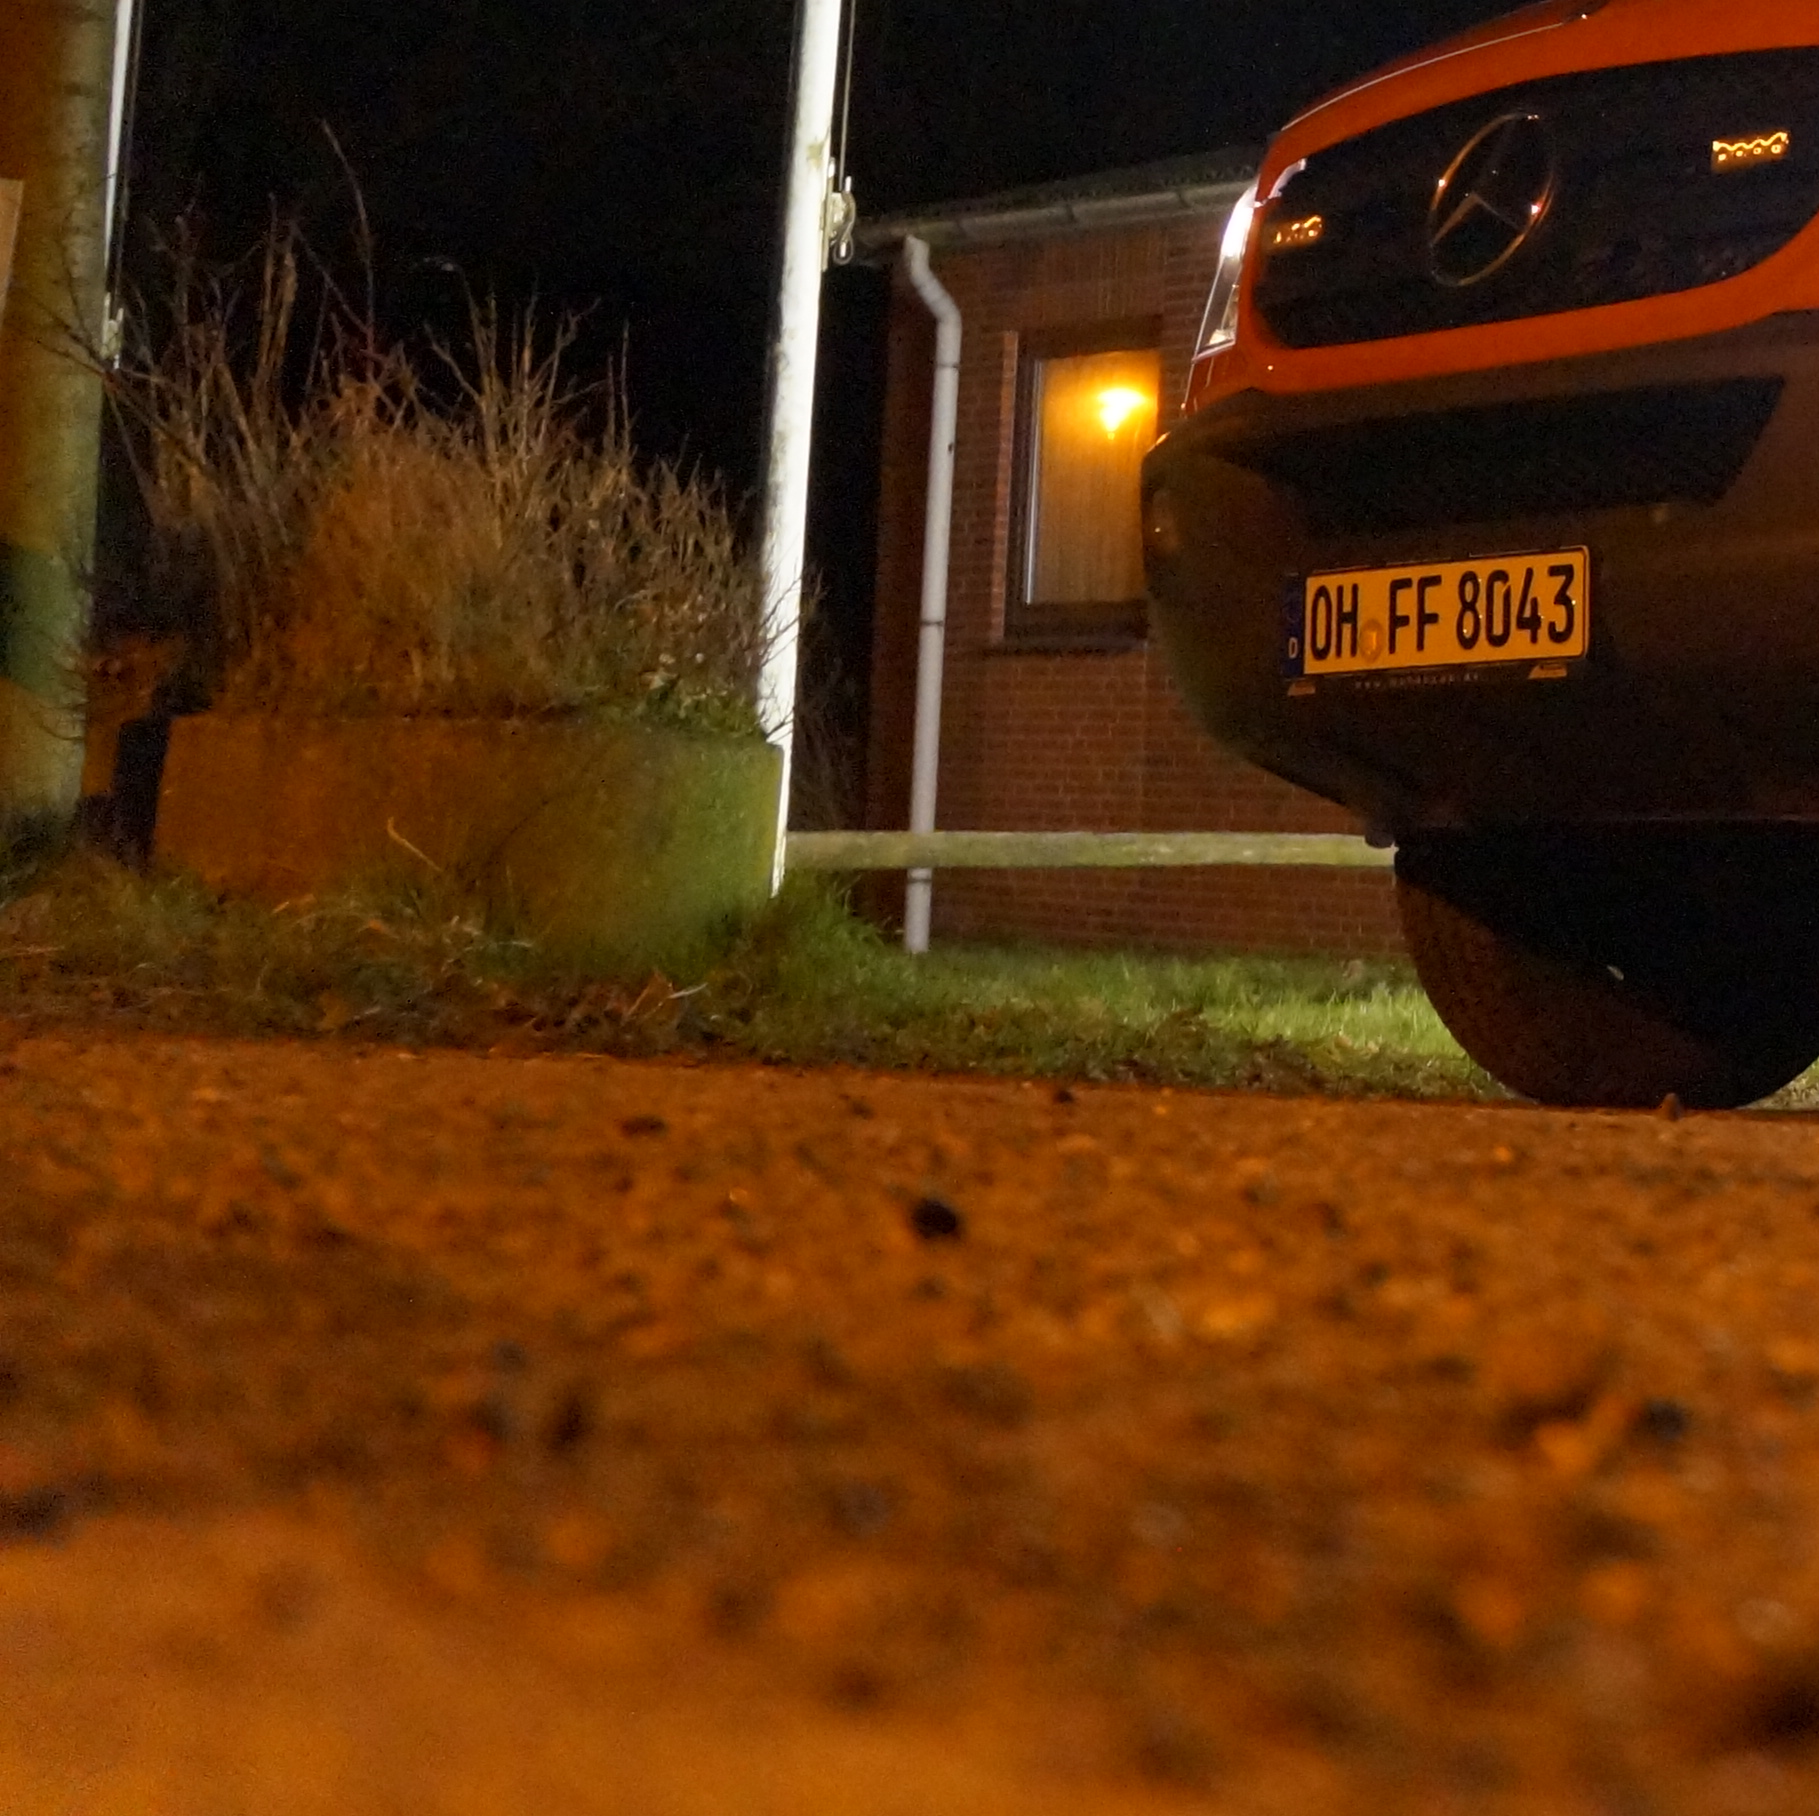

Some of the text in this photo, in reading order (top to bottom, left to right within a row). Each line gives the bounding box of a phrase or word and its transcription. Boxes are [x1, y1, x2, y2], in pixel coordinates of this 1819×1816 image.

[1310, 563, 1576, 661] OH FF 8043
